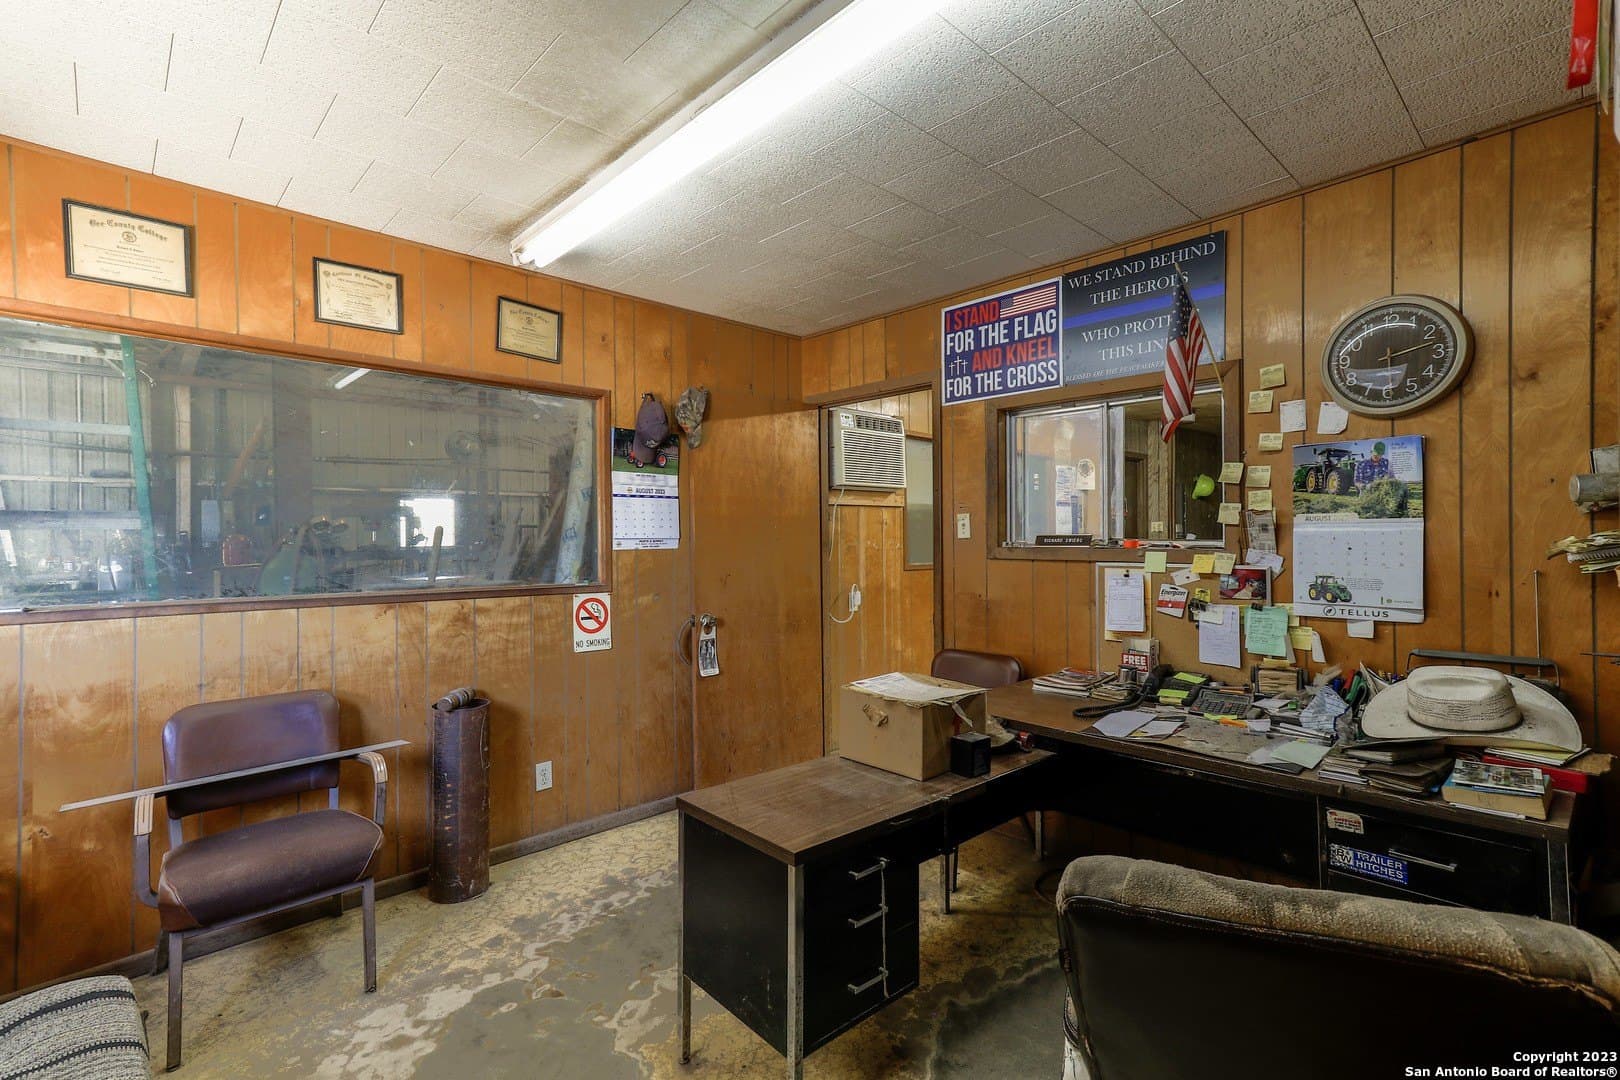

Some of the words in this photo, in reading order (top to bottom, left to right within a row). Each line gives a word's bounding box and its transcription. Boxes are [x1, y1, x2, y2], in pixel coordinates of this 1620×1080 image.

[138, 224, 168, 241] College
[1068, 273, 1092, 289] WE
[1094, 260, 1146, 284] STAND
[1150, 241, 1216, 269] BEHIND
[1089, 288, 1121, 305] THE
[946, 312, 951, 333] I
[954, 301, 1000, 330] STAND
[946, 329, 974, 356] FOR
[978, 320, 1009, 348] THE
[1014, 309, 1056, 341] FLAG
[1081, 326, 1120, 343] WHO
[1423, 324, 1436, 340] 2
[972, 346, 1002, 372] AND
[1006, 336, 1057, 366] KNEEL
[1098, 344, 1134, 361] THIS
[1138, 336, 1168, 354] LIN
[1432, 344, 1445, 359] 3
[1339, 355, 1350, 370] 9
[946, 376, 972, 398] FOR
[975, 370, 1003, 394] THE
[1007, 360, 1058, 388] CROSS
[1346, 372, 1357, 386] 8
[1422, 364, 1434, 378] 4
[1361, 382, 1374, 396] 7
[1382, 384, 1394, 399] 6
[1406, 378, 1418, 392] 5
[1304, 513, 1331, 522] AUGUST
[1339, 608, 1389, 618] TELLUS
[576, 640, 584, 649] NO
[586, 638, 610, 648] SMOKING
[1122, 654, 1146, 666] FREE
[1356, 852, 1402, 870] TRAILER
[1356, 860, 1404, 879] HITCHES
